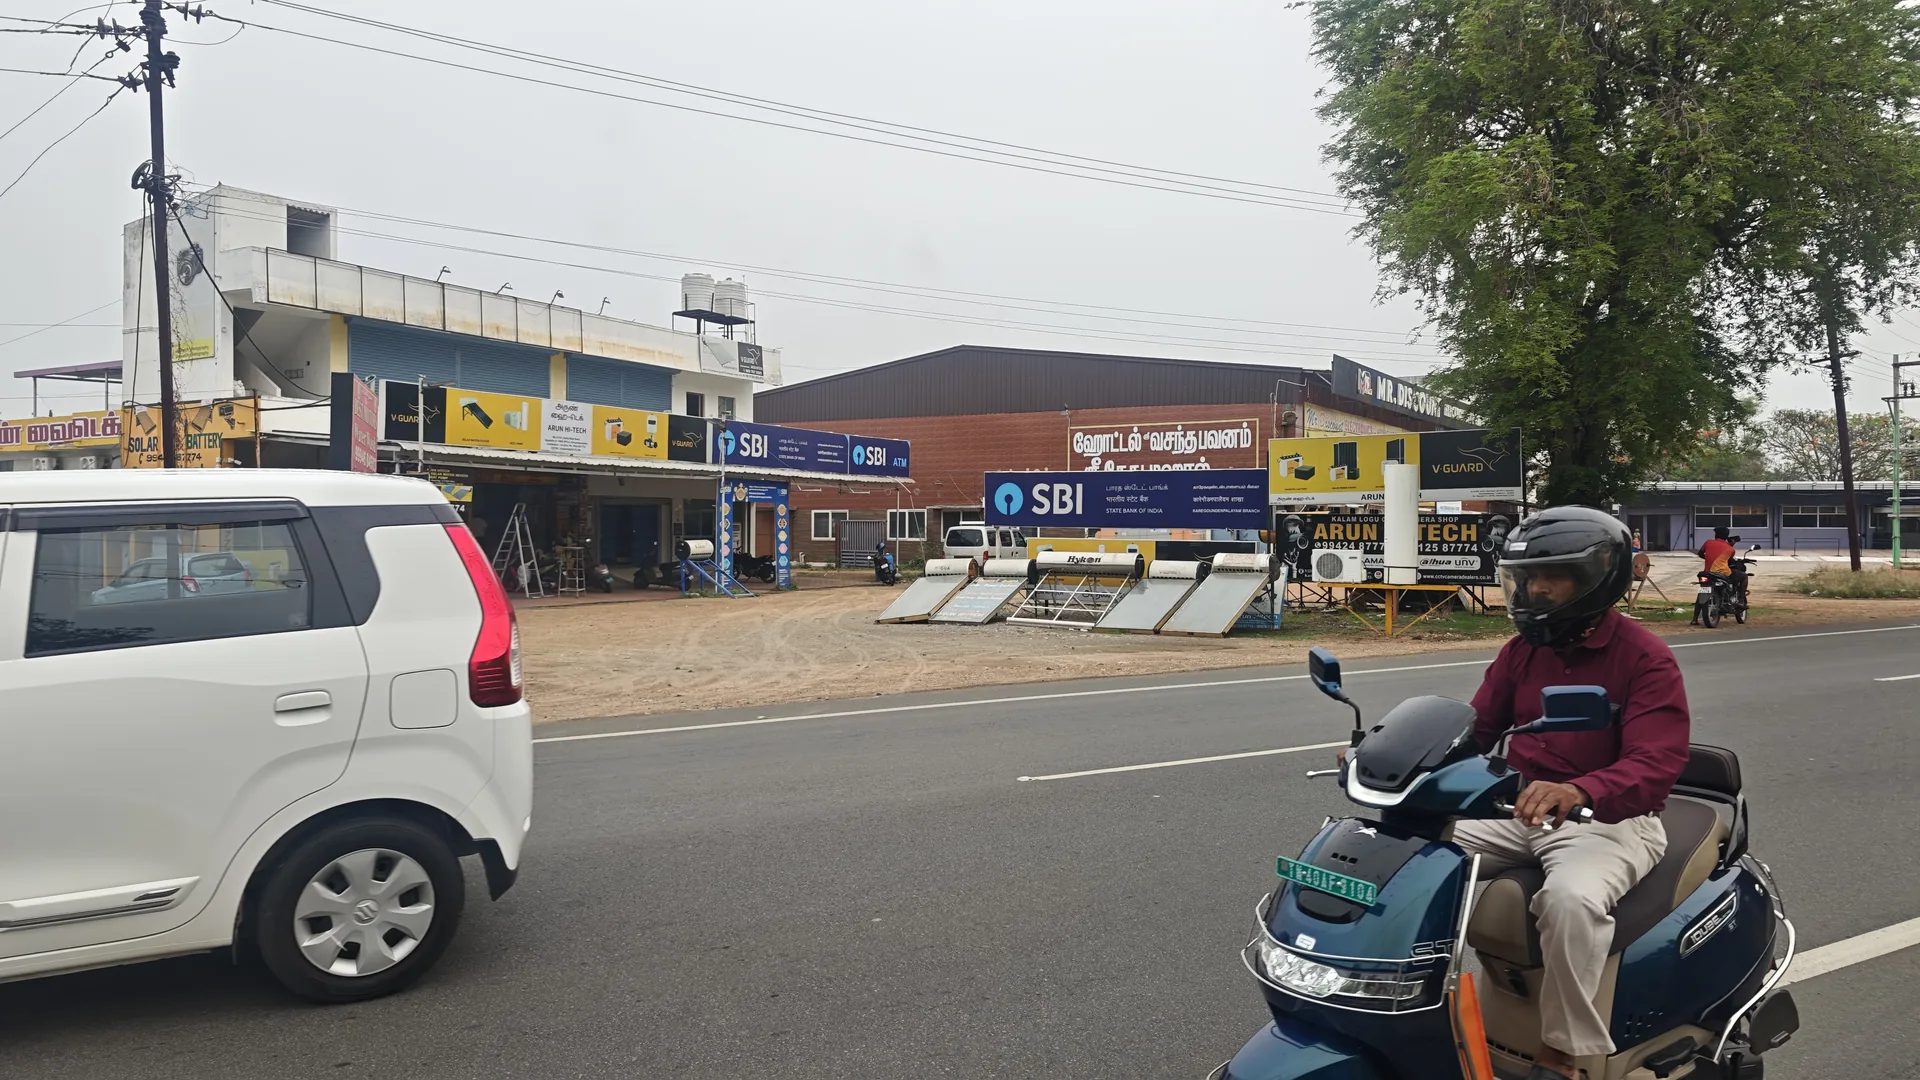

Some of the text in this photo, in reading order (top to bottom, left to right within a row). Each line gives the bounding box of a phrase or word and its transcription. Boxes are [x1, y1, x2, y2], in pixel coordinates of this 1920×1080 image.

[391, 413, 419, 424] V-GUAR
[548, 424, 587, 434] ARUN HI-TECH
[129, 432, 223, 453] SOLAR BATTERY
[672, 440, 693, 448] V-GUARD
[739, 432, 768, 459] SBI
[1073, 426, 1142, 457] ஹோட்டல்
[866, 446, 907, 468] SBI ATM
[1432, 462, 1484, 474] V-GUARD
[1031, 483, 1083, 515] SBI
[1313, 523, 1377, 541] ARUN
[1322, 541, 1355, 550] 99424
[1441, 543, 1478, 552] 87774
[1410, 938, 1455, 966] ST
